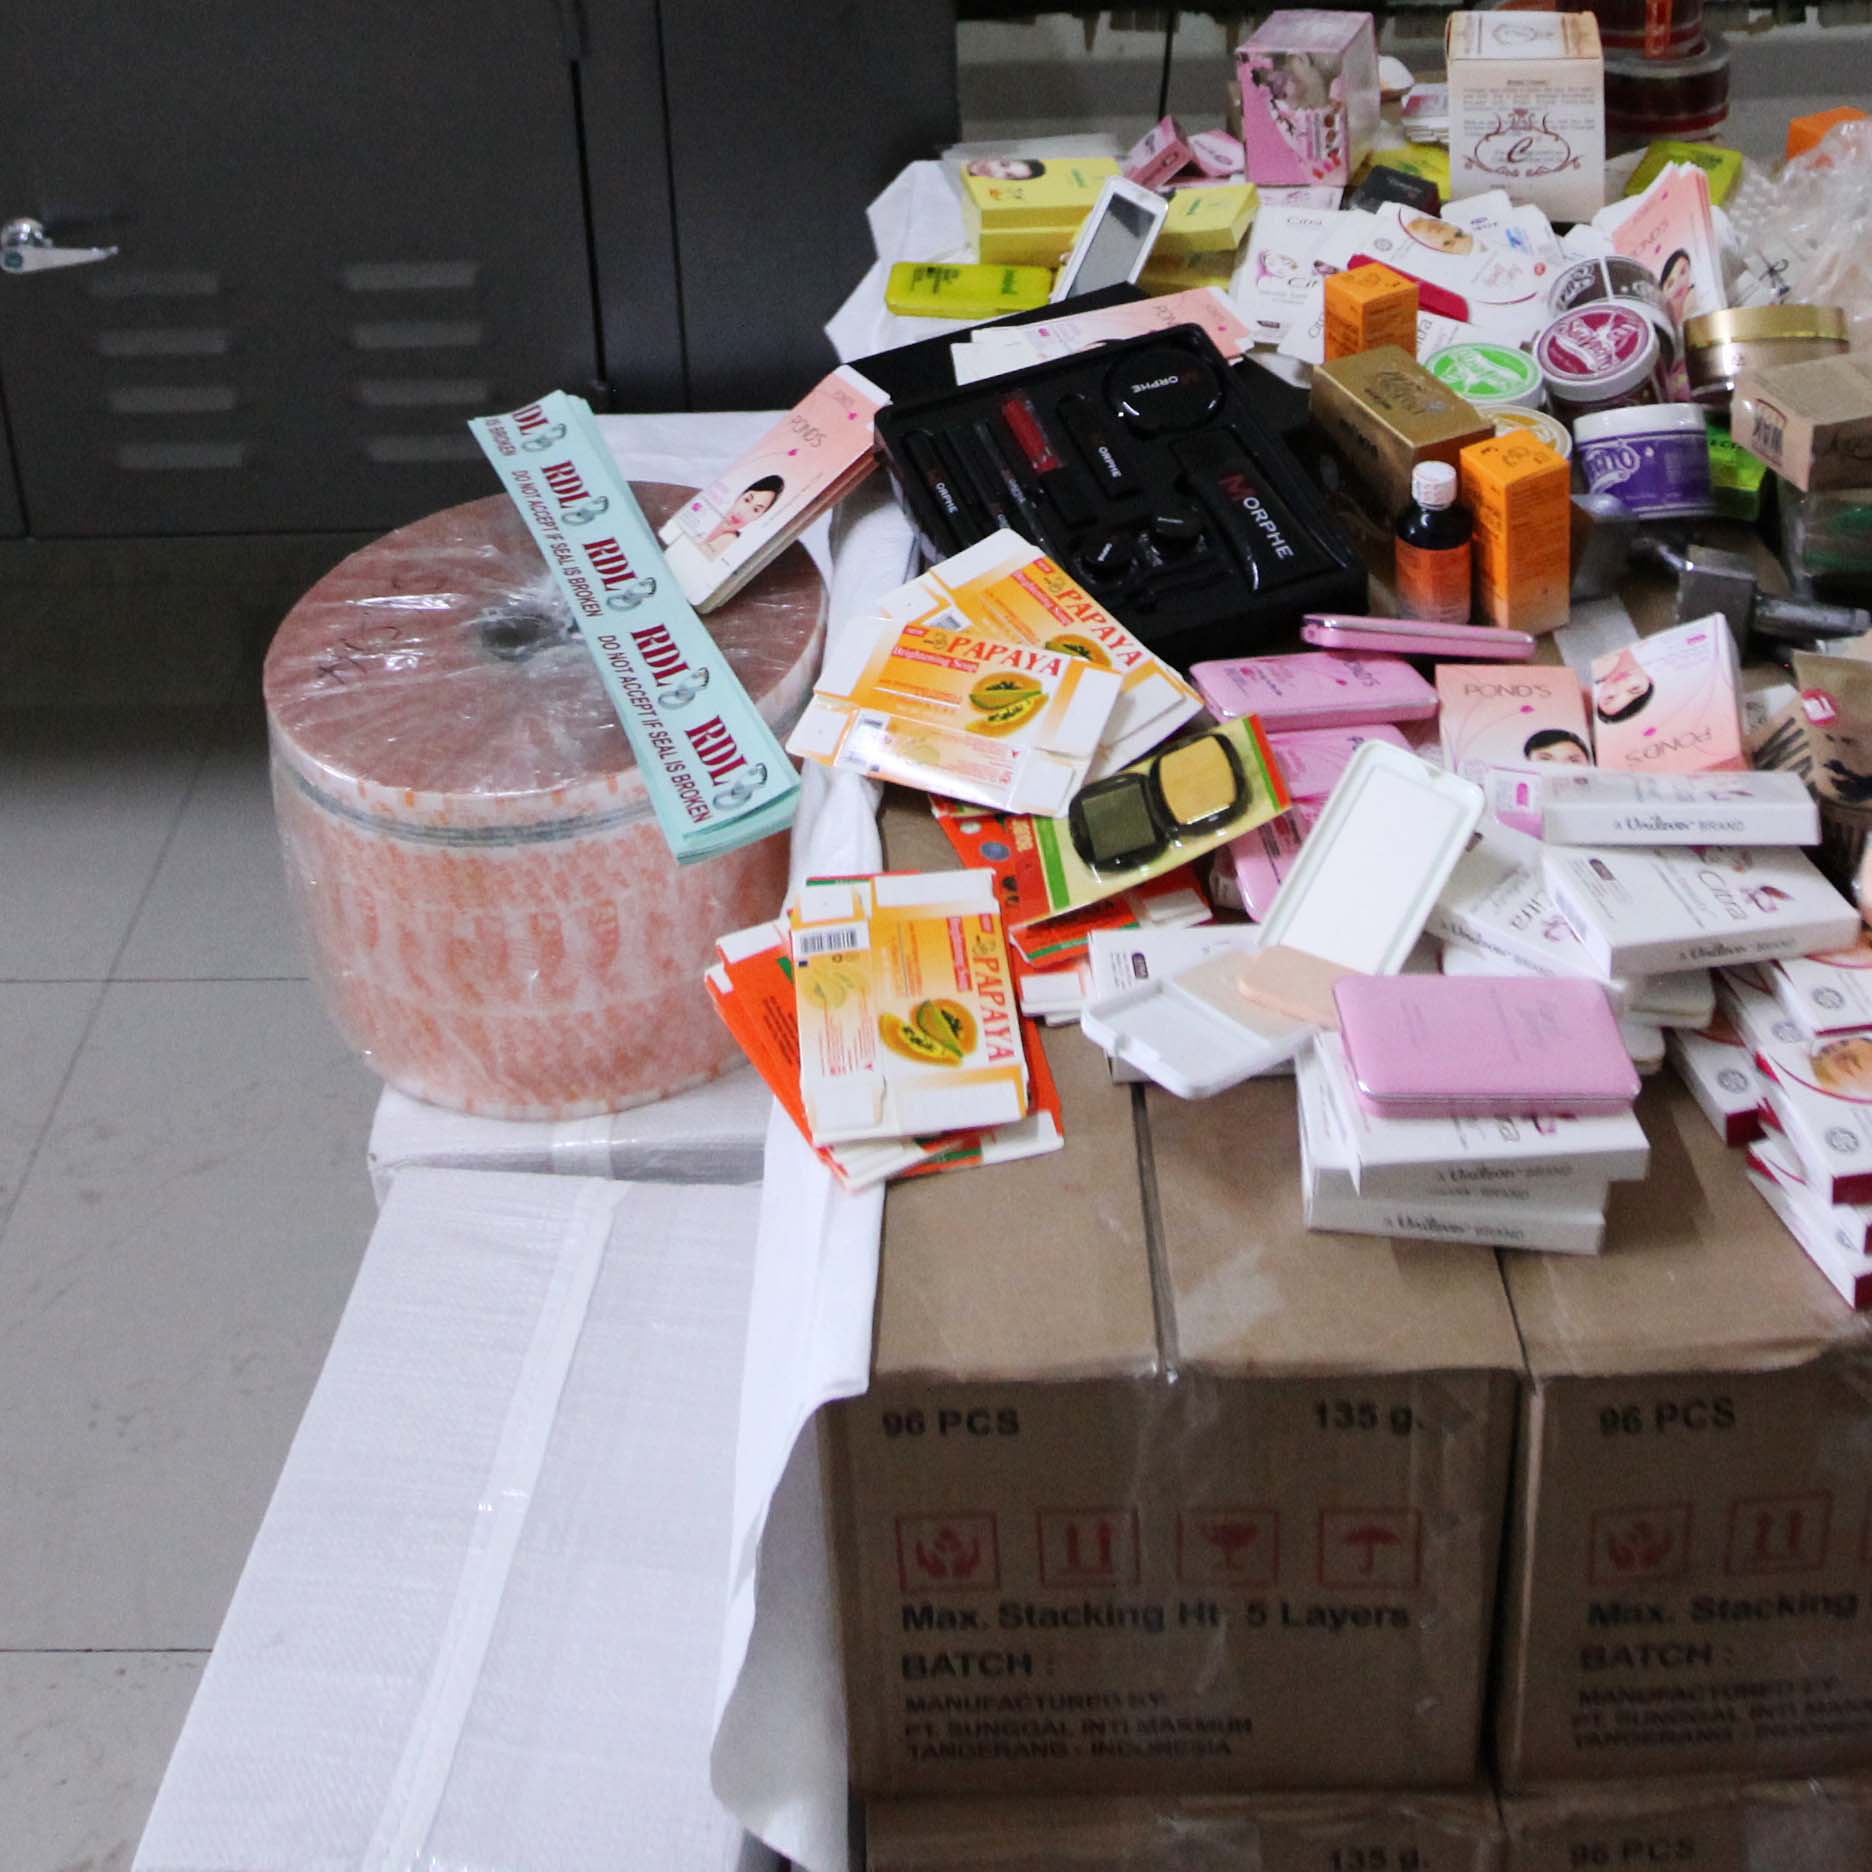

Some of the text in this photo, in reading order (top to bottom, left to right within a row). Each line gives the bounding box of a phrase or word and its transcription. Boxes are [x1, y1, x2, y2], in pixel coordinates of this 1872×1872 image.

[512, 404, 550, 436] DL
[511, 469, 531, 482] DO
[519, 483, 541, 498] NOT
[540, 459, 591, 510] RDL
[528, 500, 560, 531] ACCEPT
[1217, 471, 1296, 560] MORPHE
[549, 542, 576, 566] SEAL
[582, 536, 638, 592] RDL
[562, 566, 583, 576] IS
[568, 577, 605, 617] BROKEN
[1056, 588, 1145, 667] PAPAYA
[629, 623, 692, 688] RDL
[947, 636, 1062, 677] PAPAYA
[1463, 682, 1554, 699] POND'S
[598, 634, 713, 824] DO NOT ACCEPT IF SEAL IS BROKEN
[684, 714, 748, 788] RDL
[972, 956, 1015, 1063] PAPAYA
[882, 1407, 1020, 1437] 96 PCS
[1317, 1400, 1379, 1430] 135
[1600, 1396, 1736, 1435] 96 PCS
[901, 1602, 990, 1630] Max.
[997, 1600, 1166, 1633] Stacking
[1246, 1601, 1268, 1628] 5
[1280, 1600, 1409, 1632] Layers
[1587, 1600, 1677, 1627] Max.
[1689, 1589, 1859, 1622] Stacking
[901, 1651, 1033, 1680] BATCH
[1580, 1642, 1713, 1672] BATCH
[1329, 1846, 1389, 1872] 135
[1568, 1835, 1696, 1867] 96 PCS
